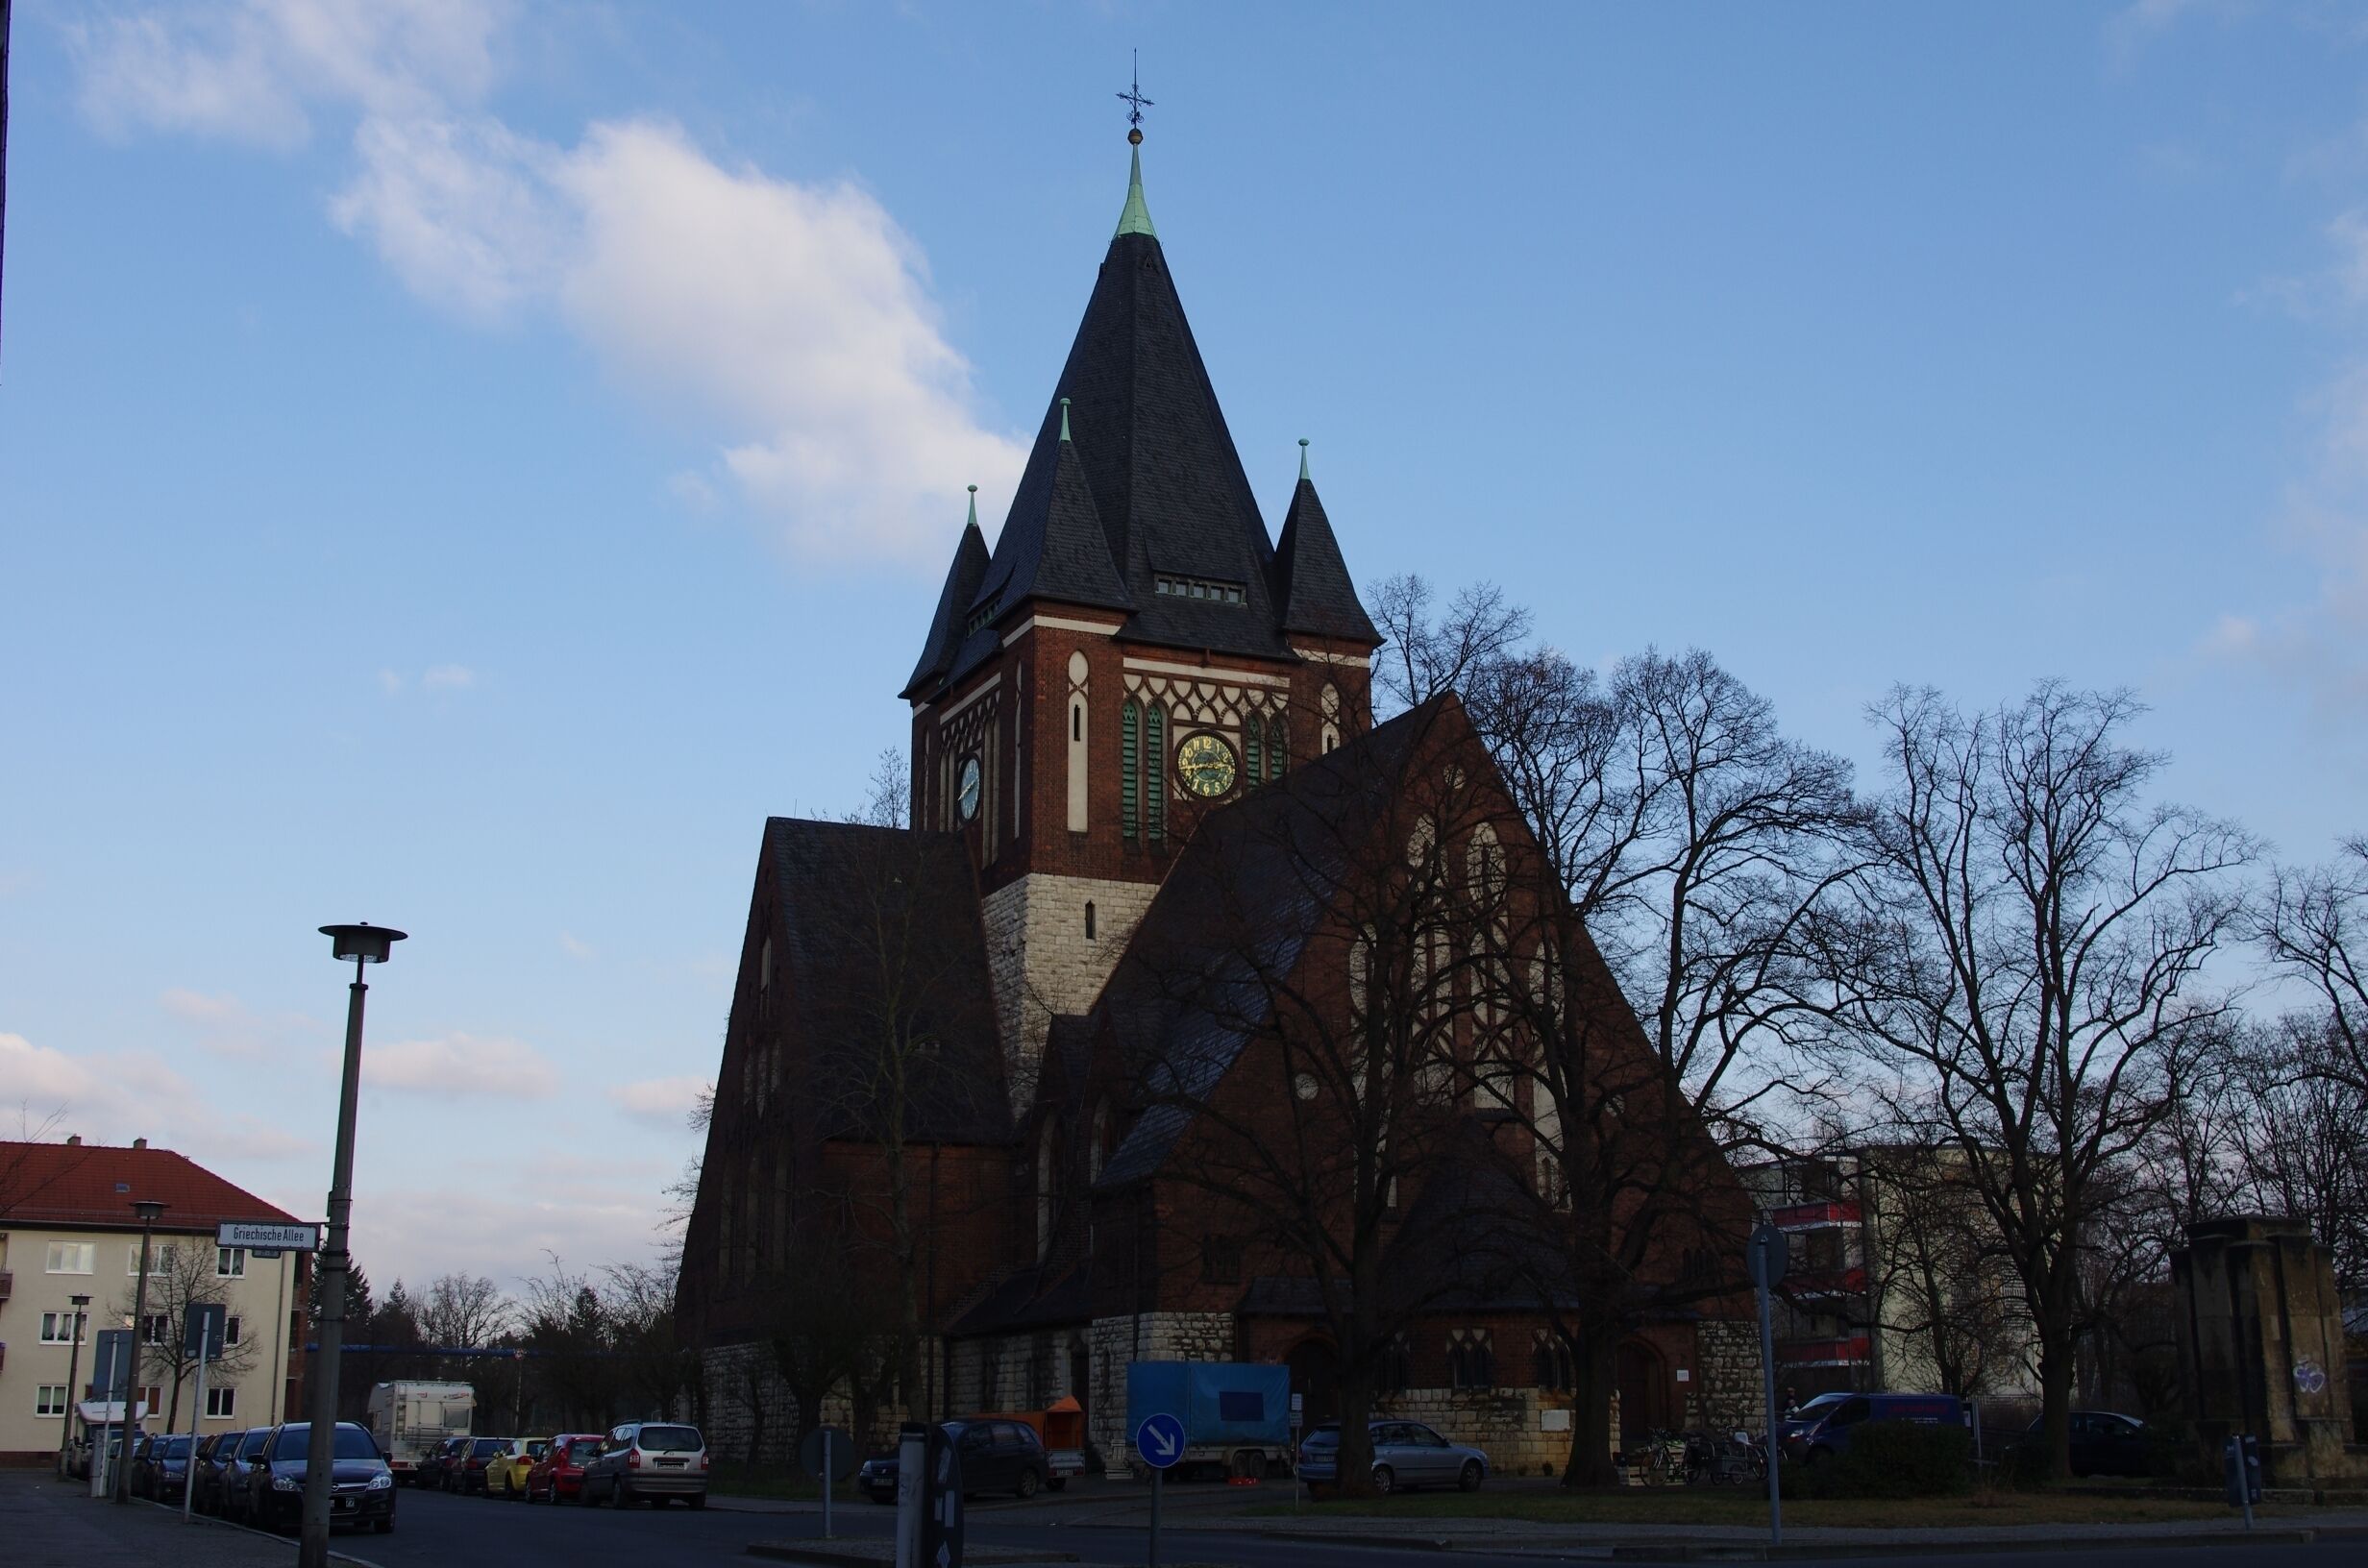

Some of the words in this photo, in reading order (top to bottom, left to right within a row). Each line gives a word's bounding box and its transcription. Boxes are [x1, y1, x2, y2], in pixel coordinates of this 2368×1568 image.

[1193, 740, 1199, 750] 11
[1203, 739, 1211, 749] 12
[1184, 747, 1193, 757] 10
[1222, 753, 1228, 762] 2
[1221, 775, 1227, 785] 4
[1203, 783, 1210, 793] 6
[1215, 782, 1221, 793] 5
[234, 1227, 282, 1240] Griechische
[283, 1229, 305, 1241] Allee
